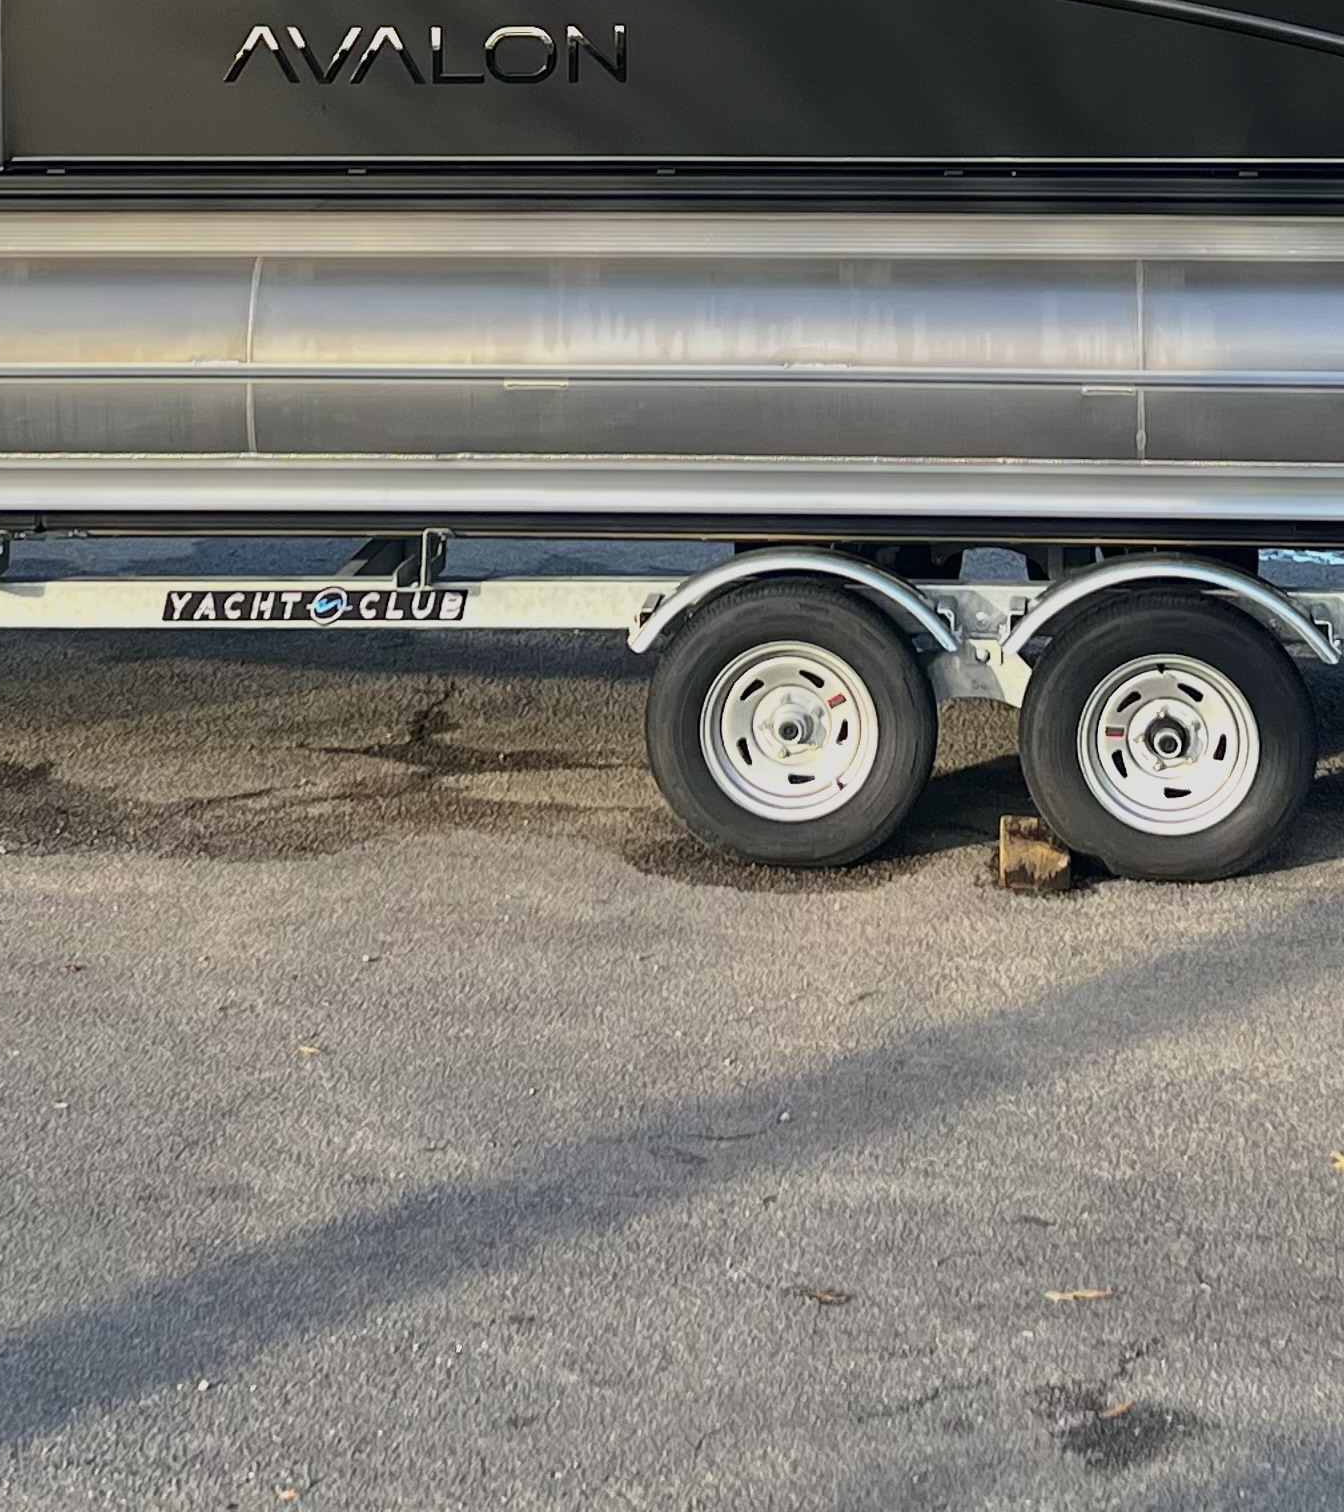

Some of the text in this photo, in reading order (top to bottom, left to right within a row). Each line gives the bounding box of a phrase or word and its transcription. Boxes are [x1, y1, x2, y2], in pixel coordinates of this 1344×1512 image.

[224, 24, 627, 84] AVALON
[170, 592, 463, 620] YACHT CLUB
